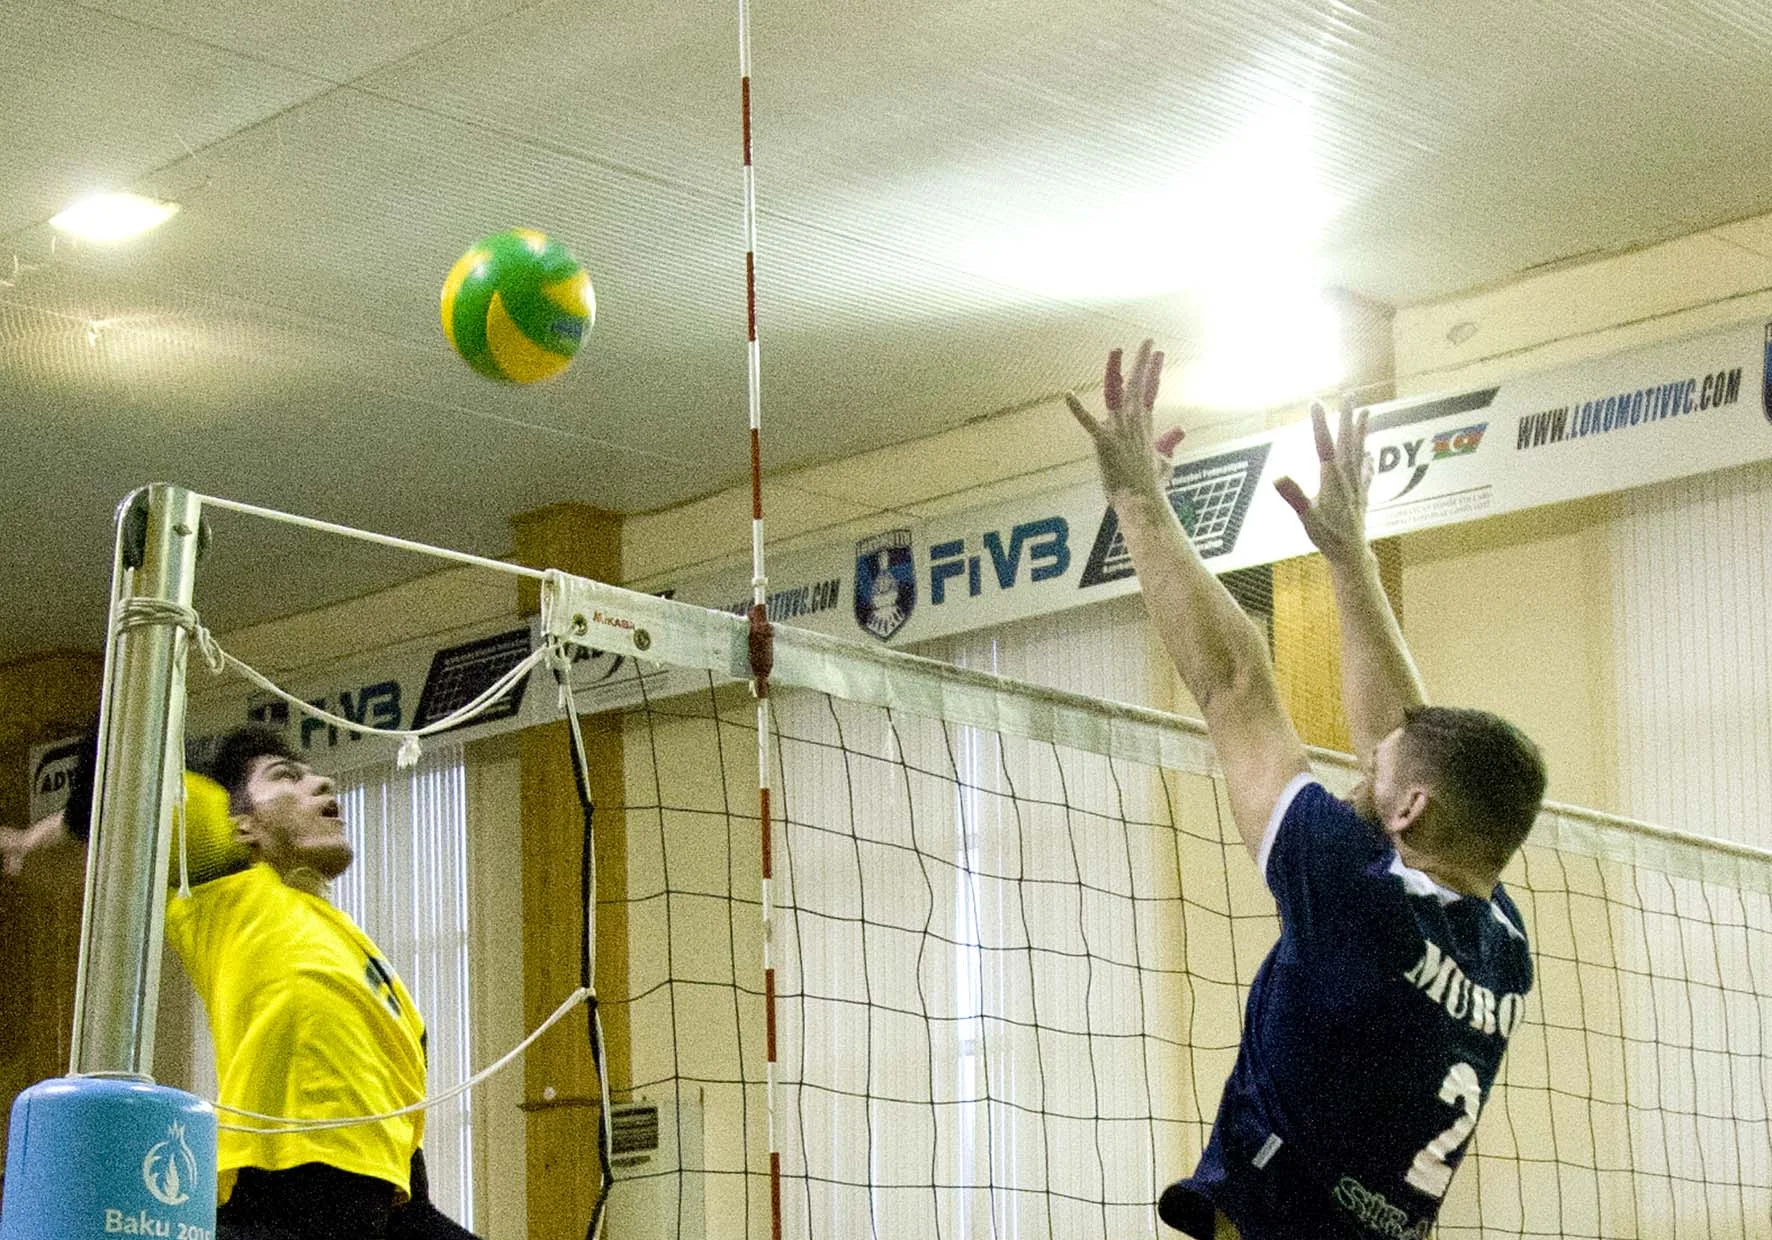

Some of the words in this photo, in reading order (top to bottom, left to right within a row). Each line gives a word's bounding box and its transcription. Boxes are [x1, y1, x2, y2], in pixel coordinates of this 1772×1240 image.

[1516, 367, 1743, 451] WWW.LOKOMOTIVVC.COM
[1378, 438, 1425, 474] DY
[1403, 1062, 1482, 1199] 2
[104, 1208, 170, 1238] Baku
